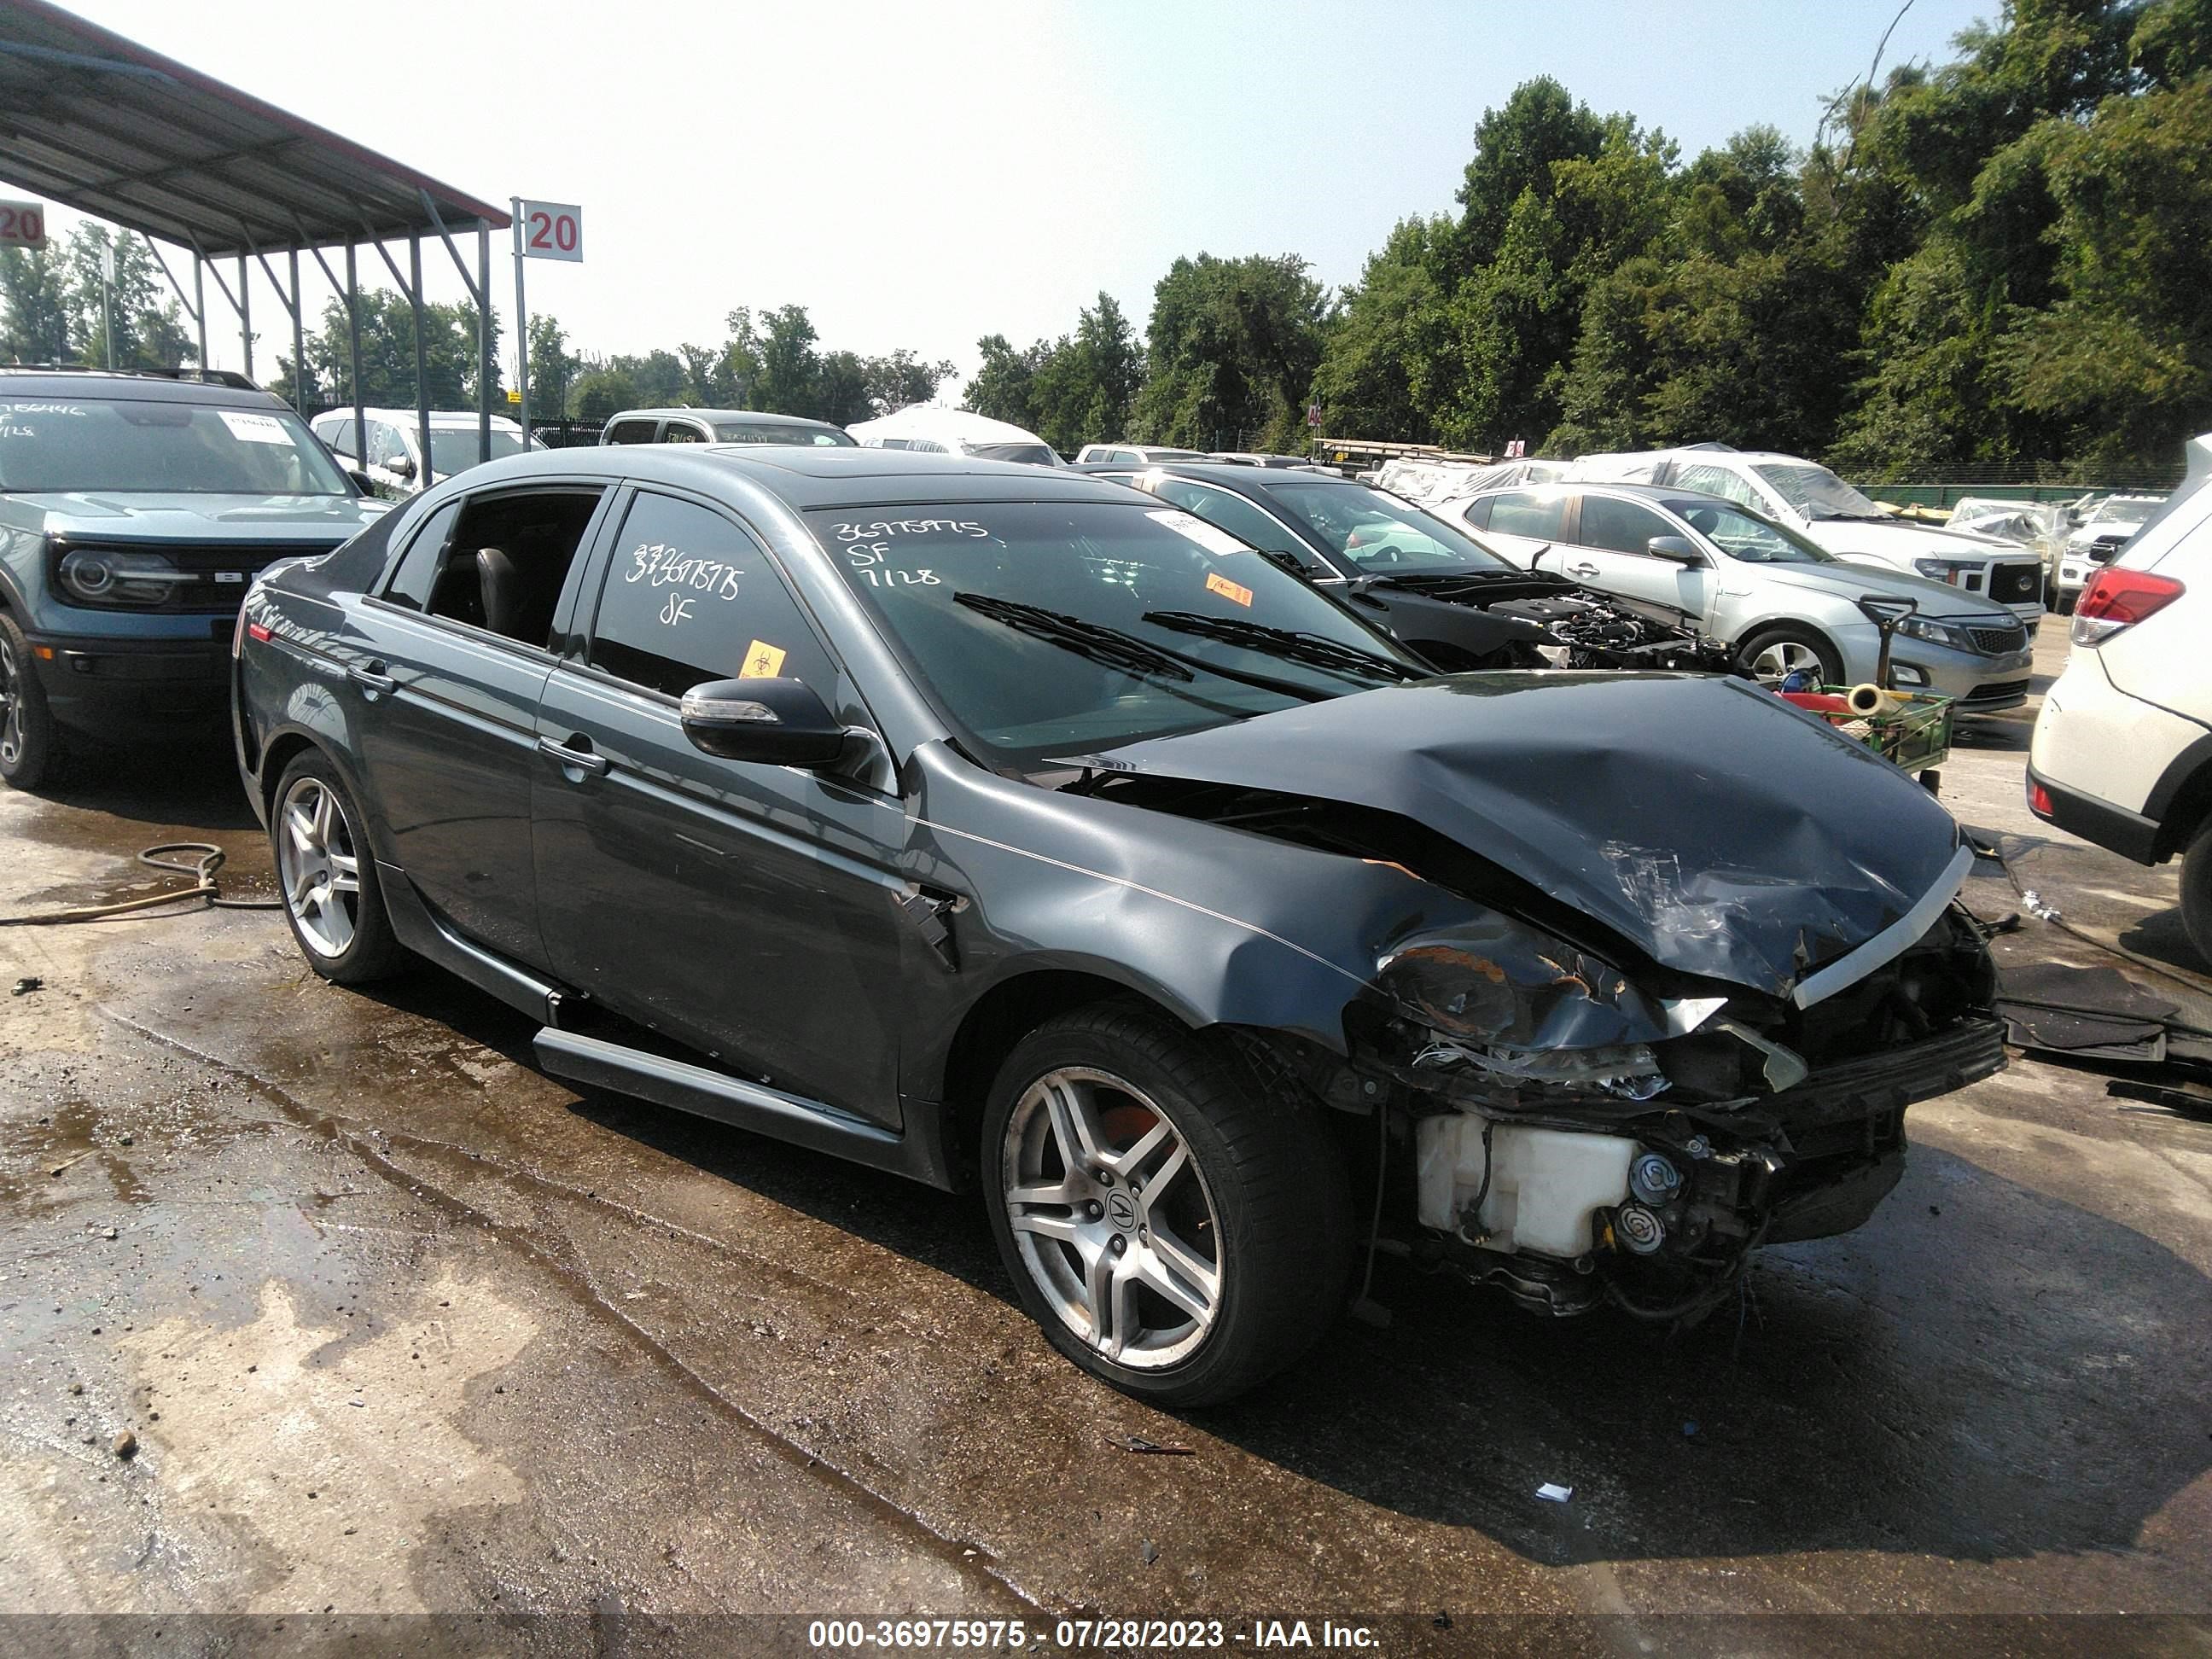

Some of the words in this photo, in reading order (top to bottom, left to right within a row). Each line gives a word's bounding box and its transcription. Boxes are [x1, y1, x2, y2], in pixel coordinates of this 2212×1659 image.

[0, 206, 41, 241] 20
[530, 212, 577, 251] 20
[831, 520, 988, 541] 36975975
[847, 542, 889, 566] SF
[660, 592, 696, 626] SF
